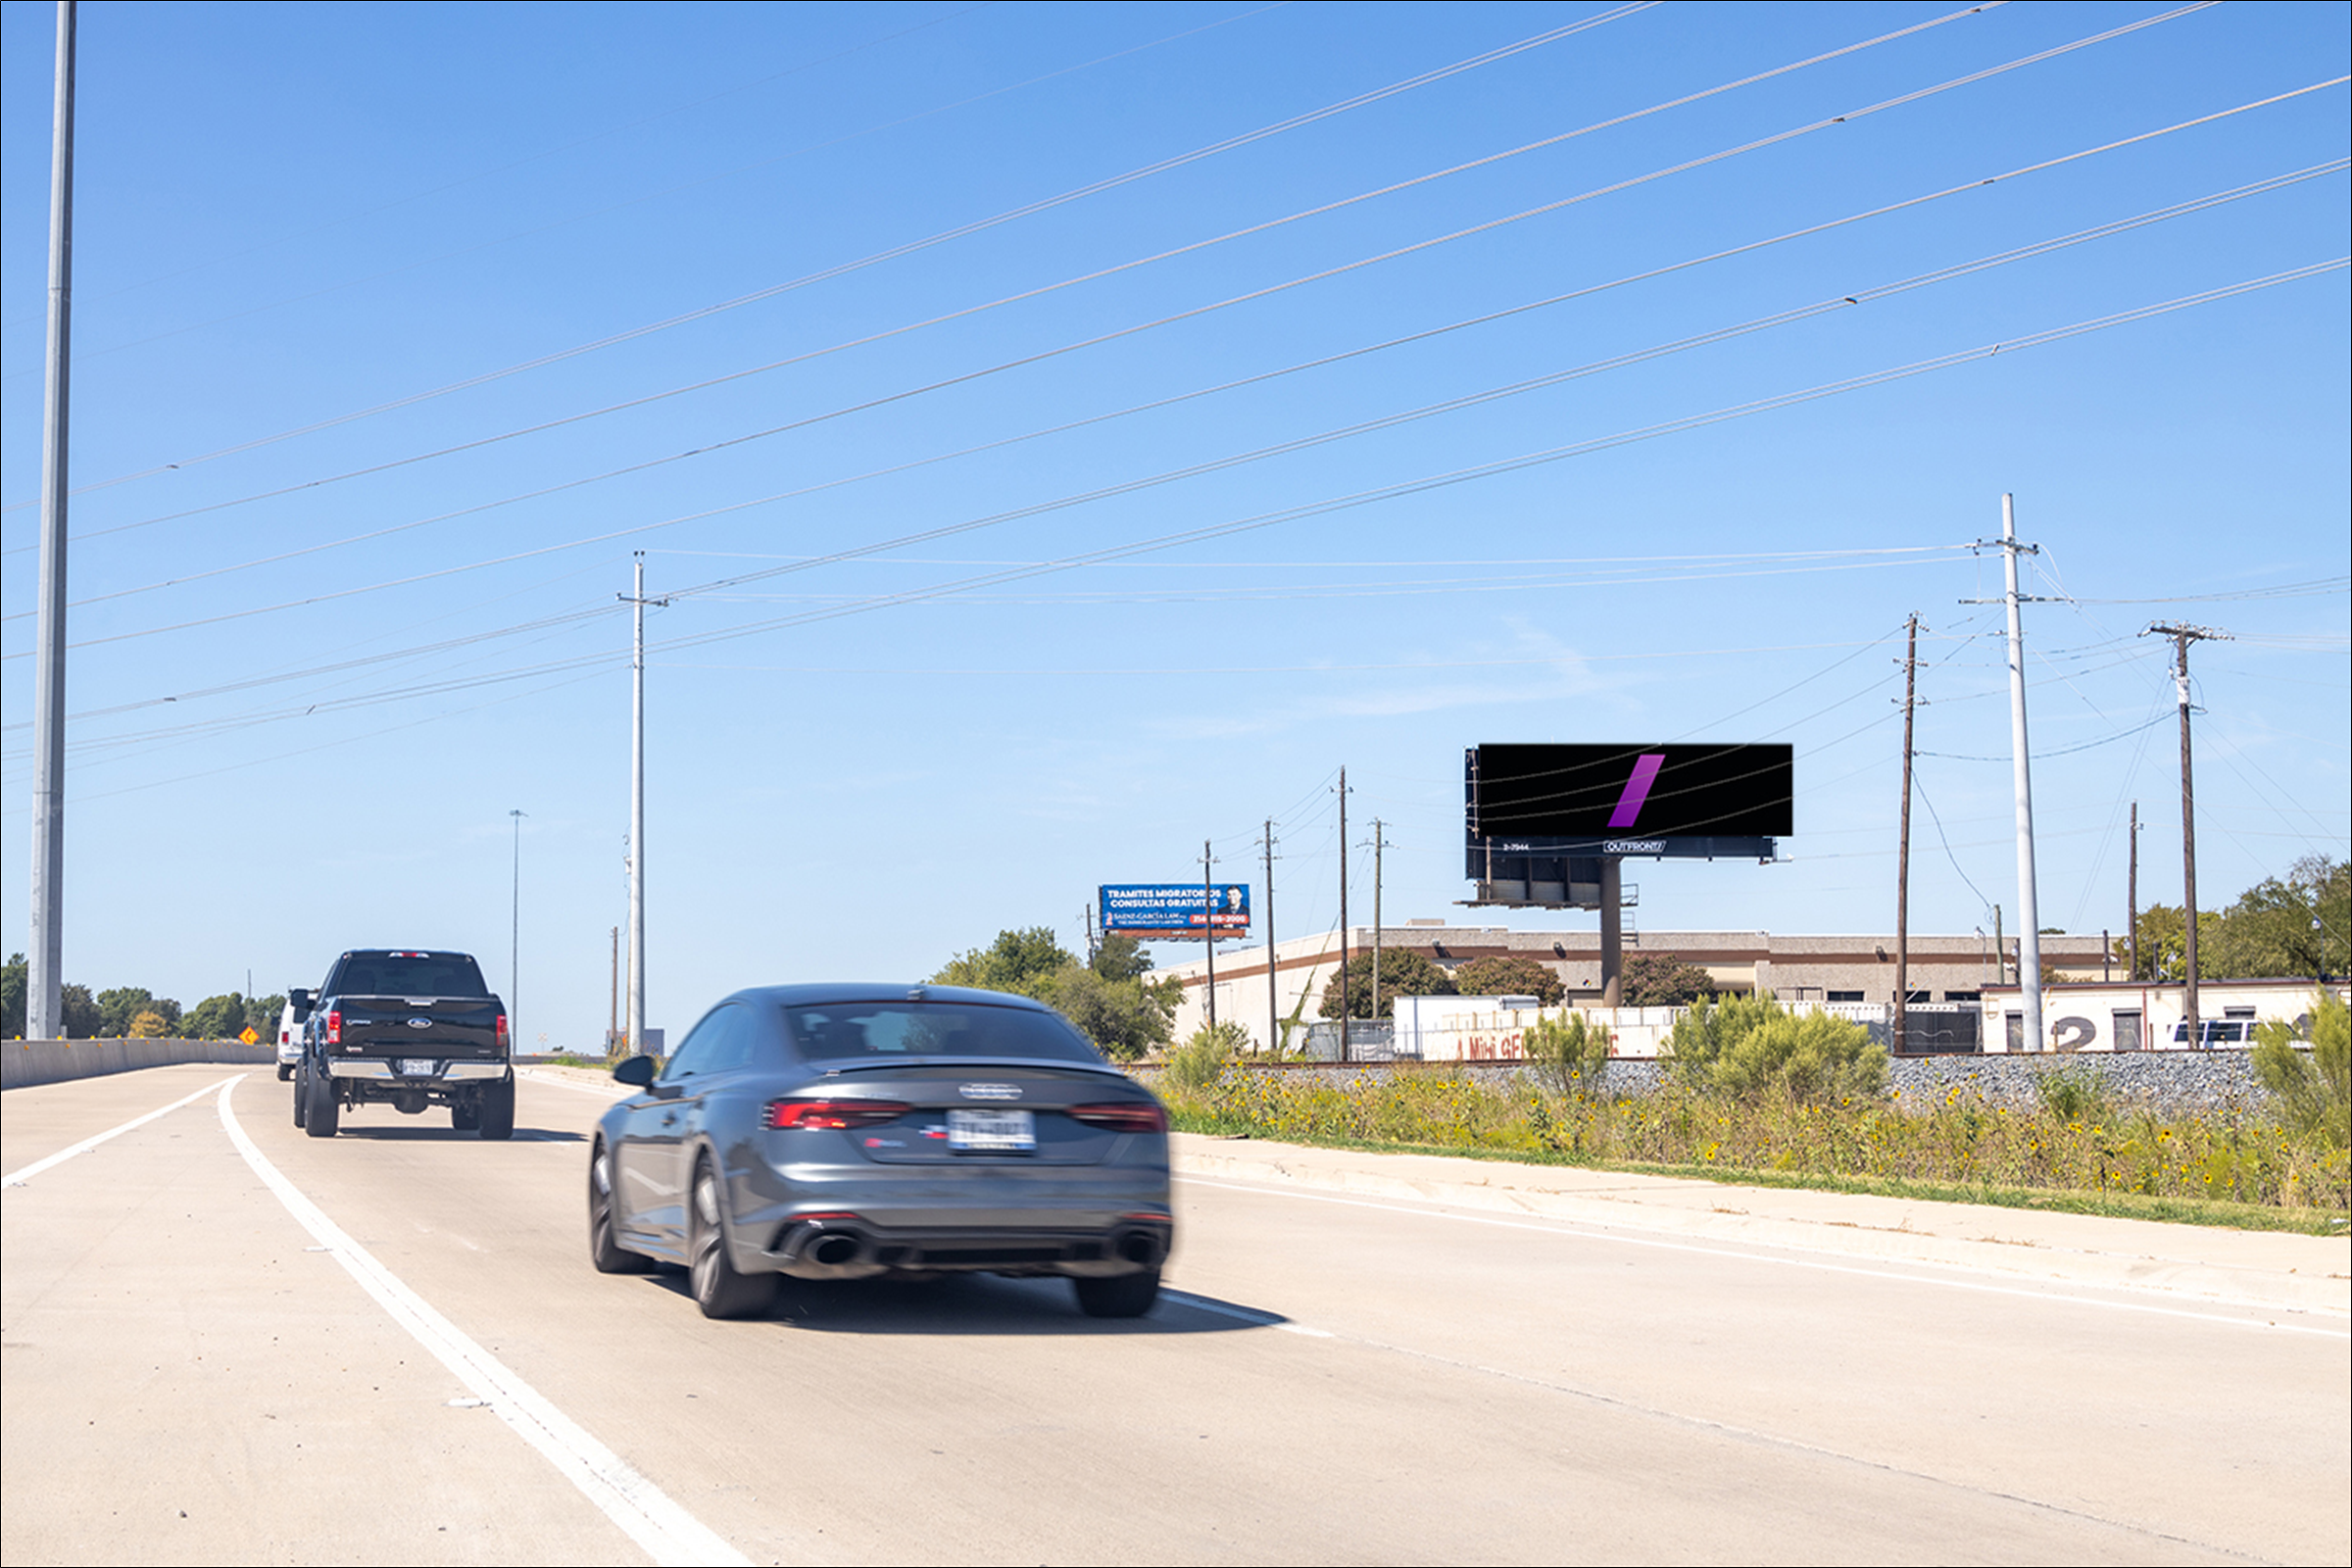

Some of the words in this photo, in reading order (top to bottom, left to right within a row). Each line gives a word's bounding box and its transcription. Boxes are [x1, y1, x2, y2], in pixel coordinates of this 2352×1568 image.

[1107, 890, 1153, 899] TRAMITES
[1155, 890, 1222, 899] MIGRATOROS
[2050, 1016, 2096, 1052] 2
